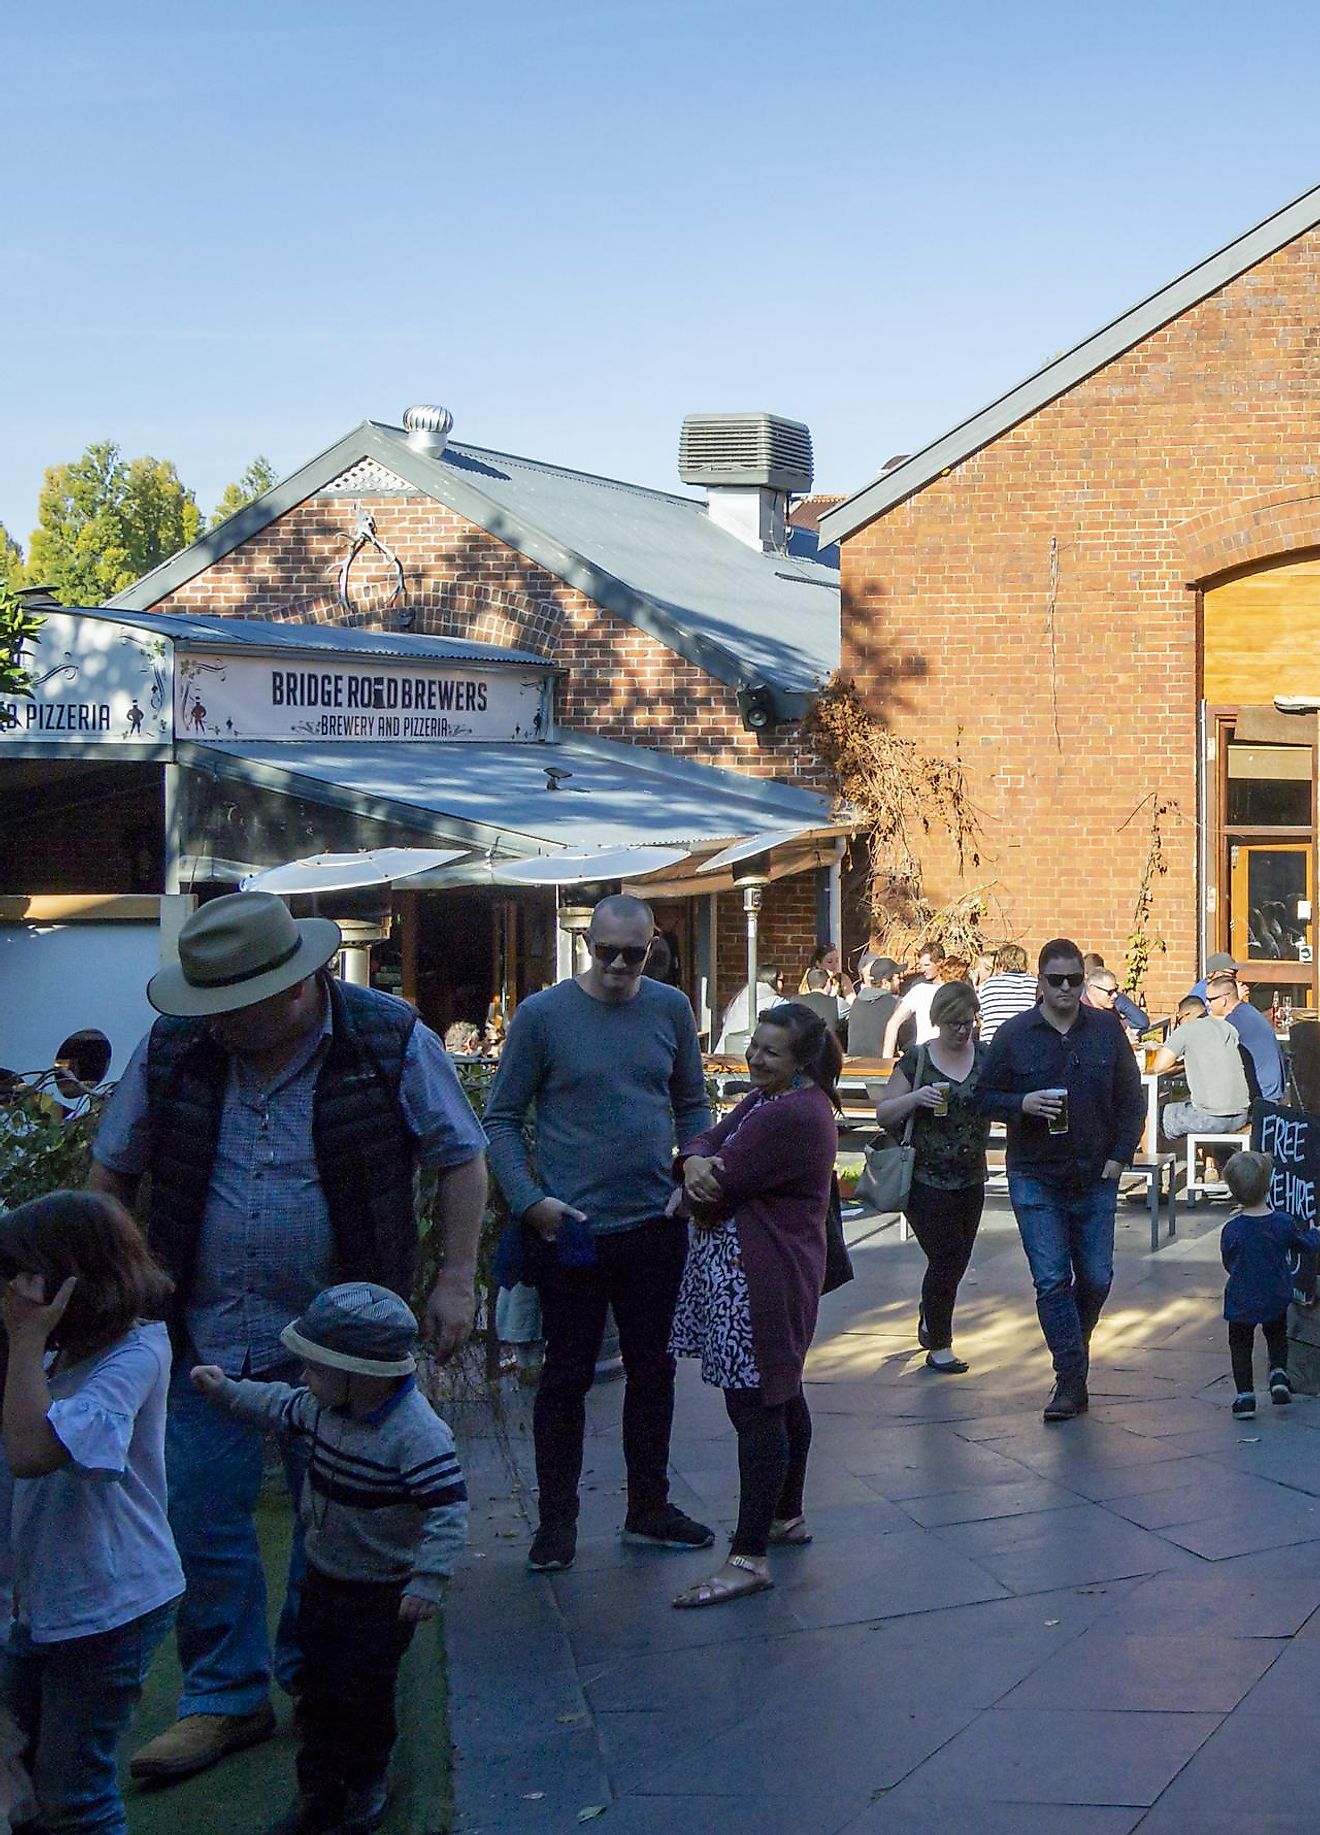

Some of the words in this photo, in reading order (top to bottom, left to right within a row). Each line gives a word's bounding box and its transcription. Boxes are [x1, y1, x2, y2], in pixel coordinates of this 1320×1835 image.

[272, 671, 343, 707] BRIDGE
[402, 679, 488, 712] BREWERS
[26, 703, 110, 730] PIZZERIA
[321, 715, 374, 736] BREWERY
[378, 717, 400, 736] AND
[403, 717, 448, 737] PIZZERIA
[1261, 1114, 1309, 1163] FREE
[1285, 1170, 1317, 1220] HIRE
